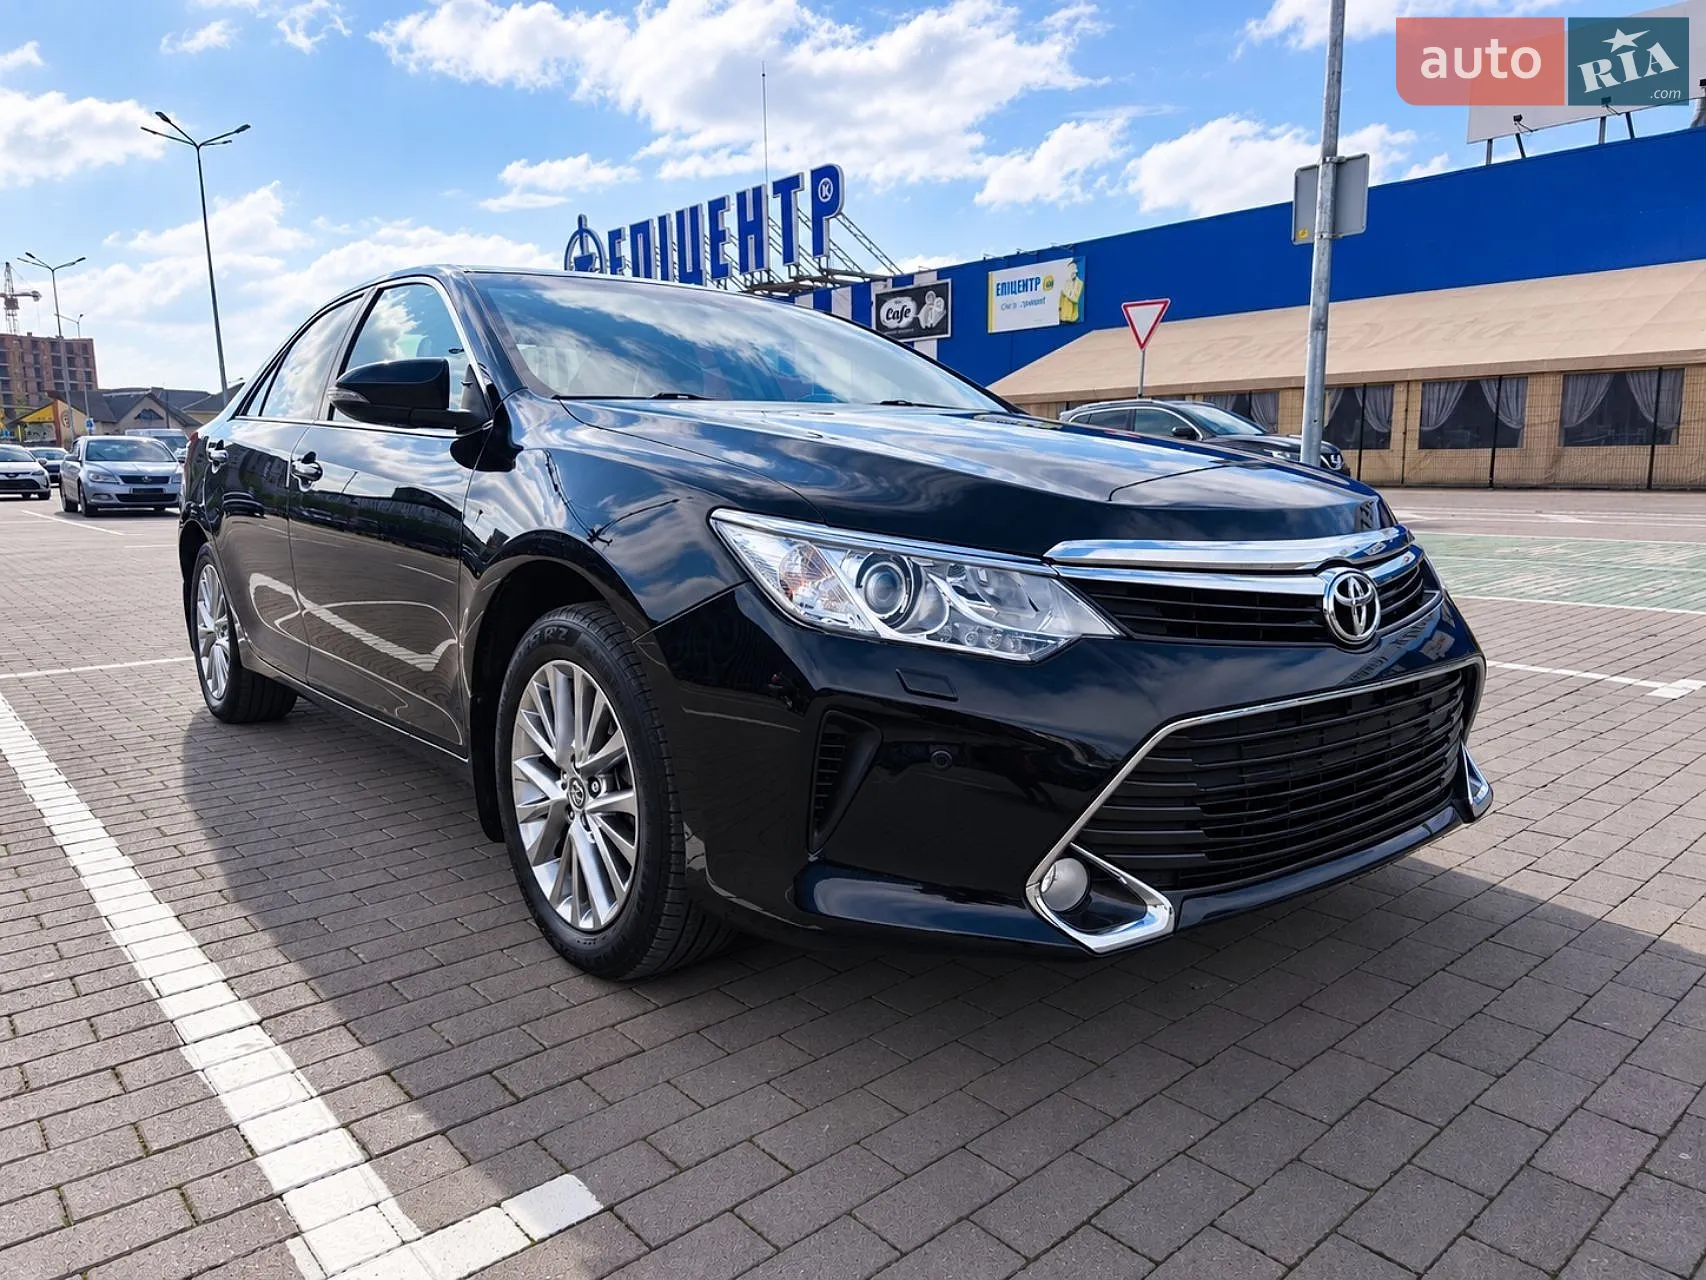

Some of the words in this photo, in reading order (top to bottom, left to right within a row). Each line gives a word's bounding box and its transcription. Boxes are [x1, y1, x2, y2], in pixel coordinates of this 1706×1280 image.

[607, 163, 845, 286] ЕПІЦЕНТР
[996, 276, 1041, 297] ЕПІЦЕНТР
[886, 305, 911, 324] Cafe
